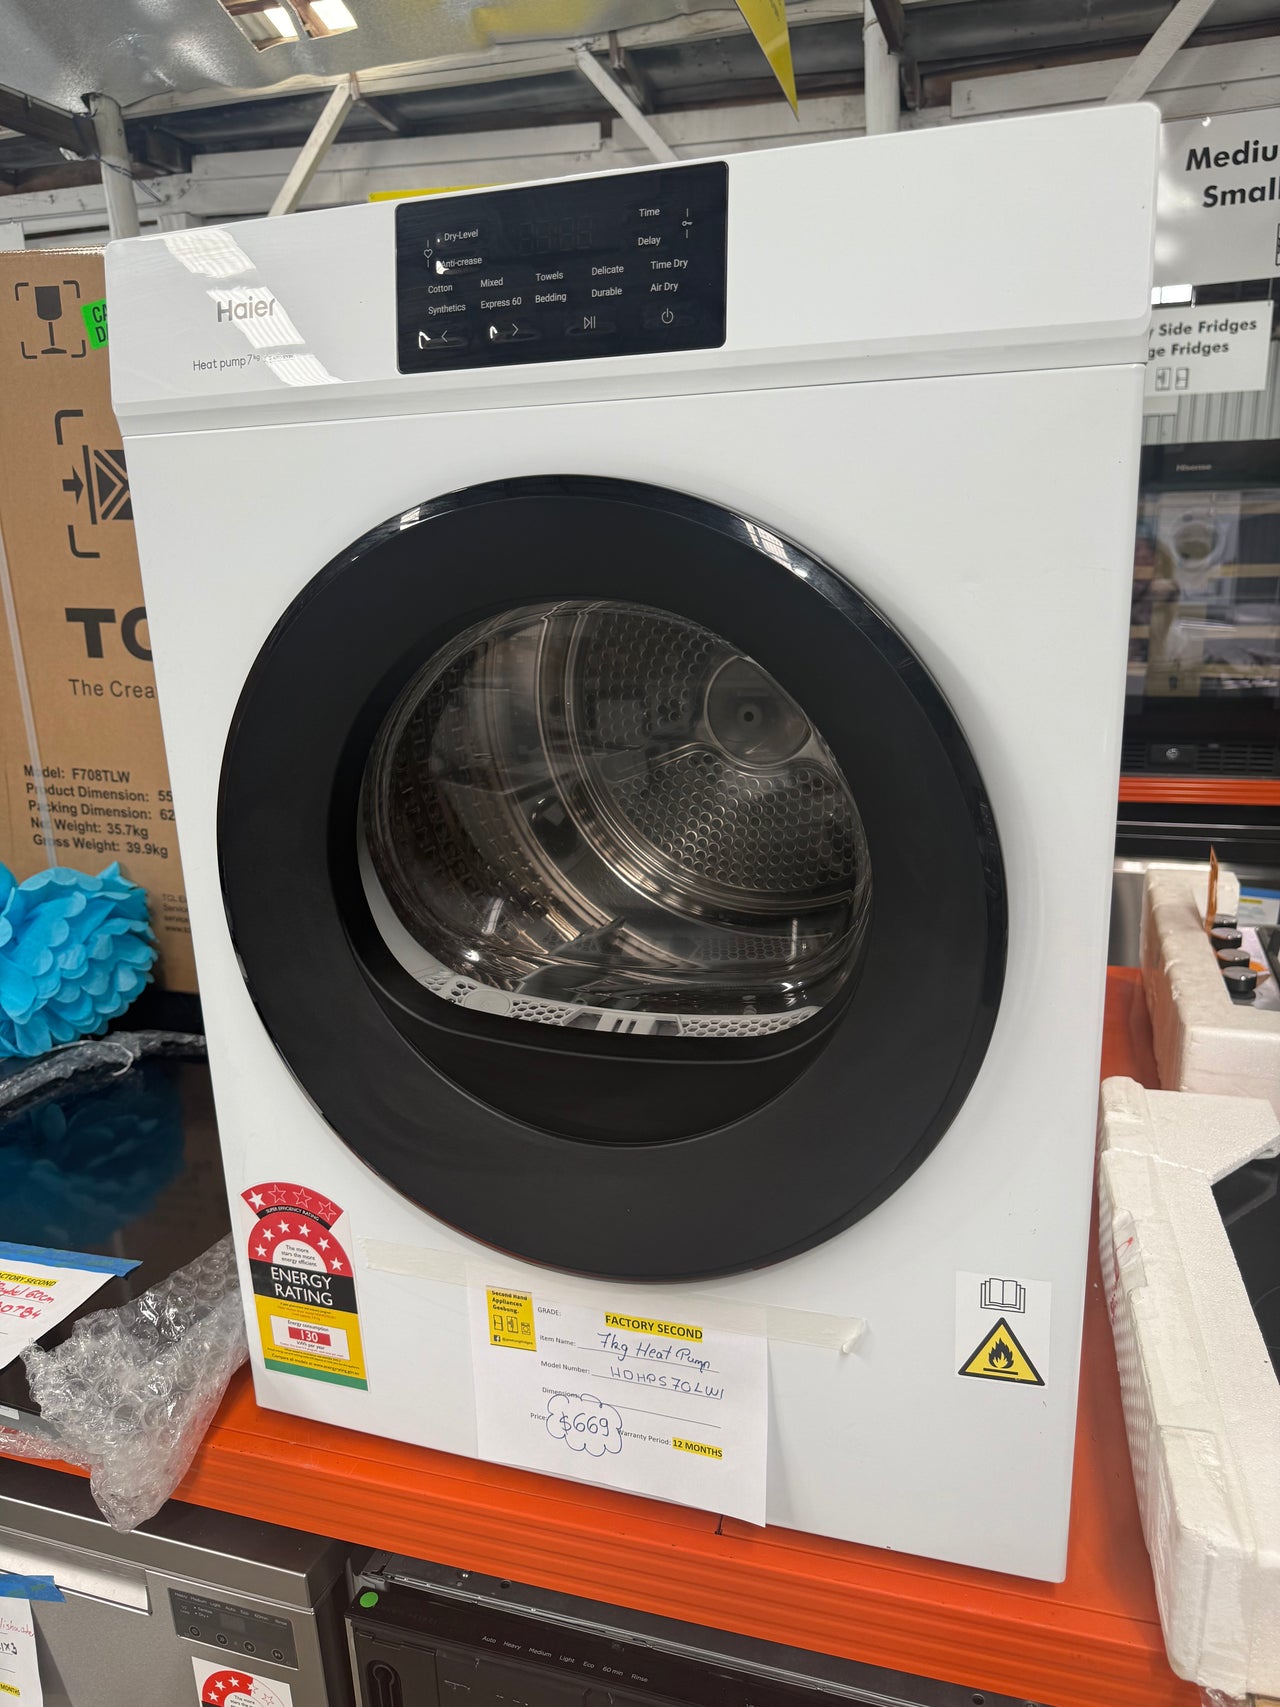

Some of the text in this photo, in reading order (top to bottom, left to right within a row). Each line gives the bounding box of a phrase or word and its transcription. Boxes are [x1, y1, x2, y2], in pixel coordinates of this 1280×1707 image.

[1185, 139, 1279, 171] Mediu
[1203, 176, 1280, 208] Smal
[639, 207, 660, 218] Time
[444, 229, 479, 242] Dry-Level
[637, 236, 661, 247] Delay
[441, 256, 482, 268] Anti-crease
[650, 258, 688, 271] Time Dry
[536, 271, 563, 282] Towels
[591, 264, 624, 276] Delicate
[428, 283, 453, 294] Cotton
[480, 277, 504, 288] Mixed
[650, 281, 678, 293] Air Dry
[535, 292, 567, 305] Bedding
[591, 286, 623, 298] Durable
[217, 296, 275, 322] Haier
[428, 303, 466, 315] Synthetics
[480, 296, 522, 311] Express 60
[95, 326, 109, 343] D
[1159, 323, 1192, 337] Side
[1198, 319, 1258, 335] Fridges
[1171, 342, 1230, 357] Fridges
[193, 359, 218, 371] Heat
[220, 356, 246, 371] pump
[69, 679, 104, 697] The
[24, 765, 131, 784] Mdel: F708TLW
[78, 786, 150, 803] Dimension:
[81, 803, 153, 820] Dimension:
[56, 819, 102, 835] Weight:
[107, 823, 149, 840] 35.7kg
[72, 837, 120, 853] Weight:
[126, 841, 169, 859] 39.9kg
[26, 1277, 57, 1287] SECOND
[270, 1266, 332, 1290] ENERGY
[275, 1283, 333, 1306] RATING
[492, 1297, 522, 1307] Appliances
[537, 1306, 703, 1341] GRADE: FACTORY SECOND
[300, 1329, 319, 1343] 130
[540, 1335, 554, 1343] Item
[555, 1337, 576, 1347] Name:
[597, 1332, 628, 1362] 7kg
[636, 1342, 672, 1361] Heat
[675, 1347, 711, 1374] Pump
[540, 1360, 562, 1371] Model
[563, 1363, 590, 1375] Number:
[559, 1410, 610, 1438] $669
[648, 1434, 671, 1447] Period:
[672, 1440, 684, 1449] 12
[684, 1441, 723, 1459] MONTHS
[481, 1635, 648, 1682] Auto Heavy Medium Light Eco 60 min Rinse
